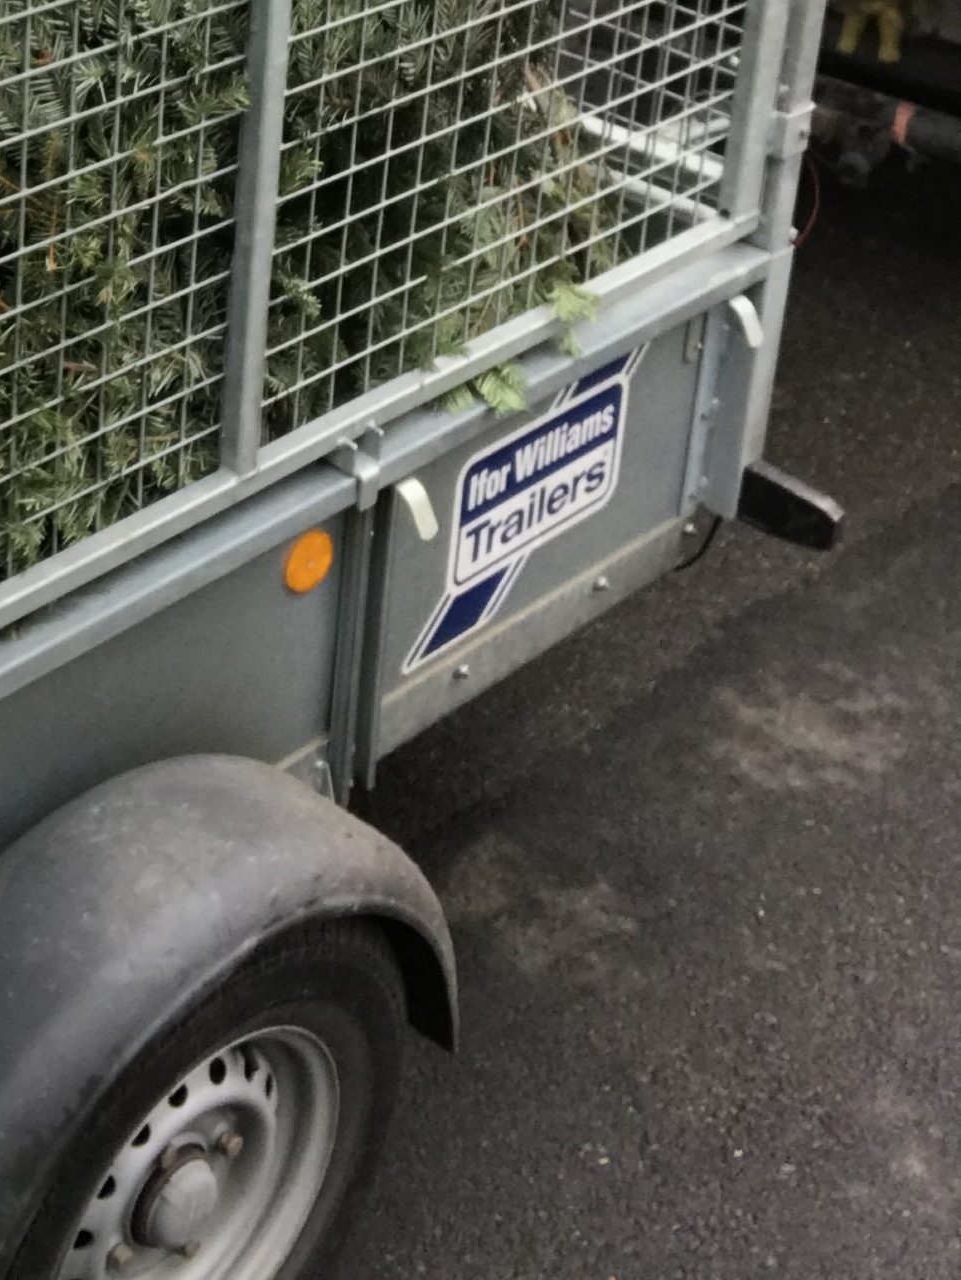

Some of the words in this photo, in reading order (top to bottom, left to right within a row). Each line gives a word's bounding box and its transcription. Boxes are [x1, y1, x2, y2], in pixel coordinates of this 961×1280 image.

[467, 462, 512, 512] Ifor
[514, 403, 615, 484] Williams
[466, 460, 606, 563] Trailers
